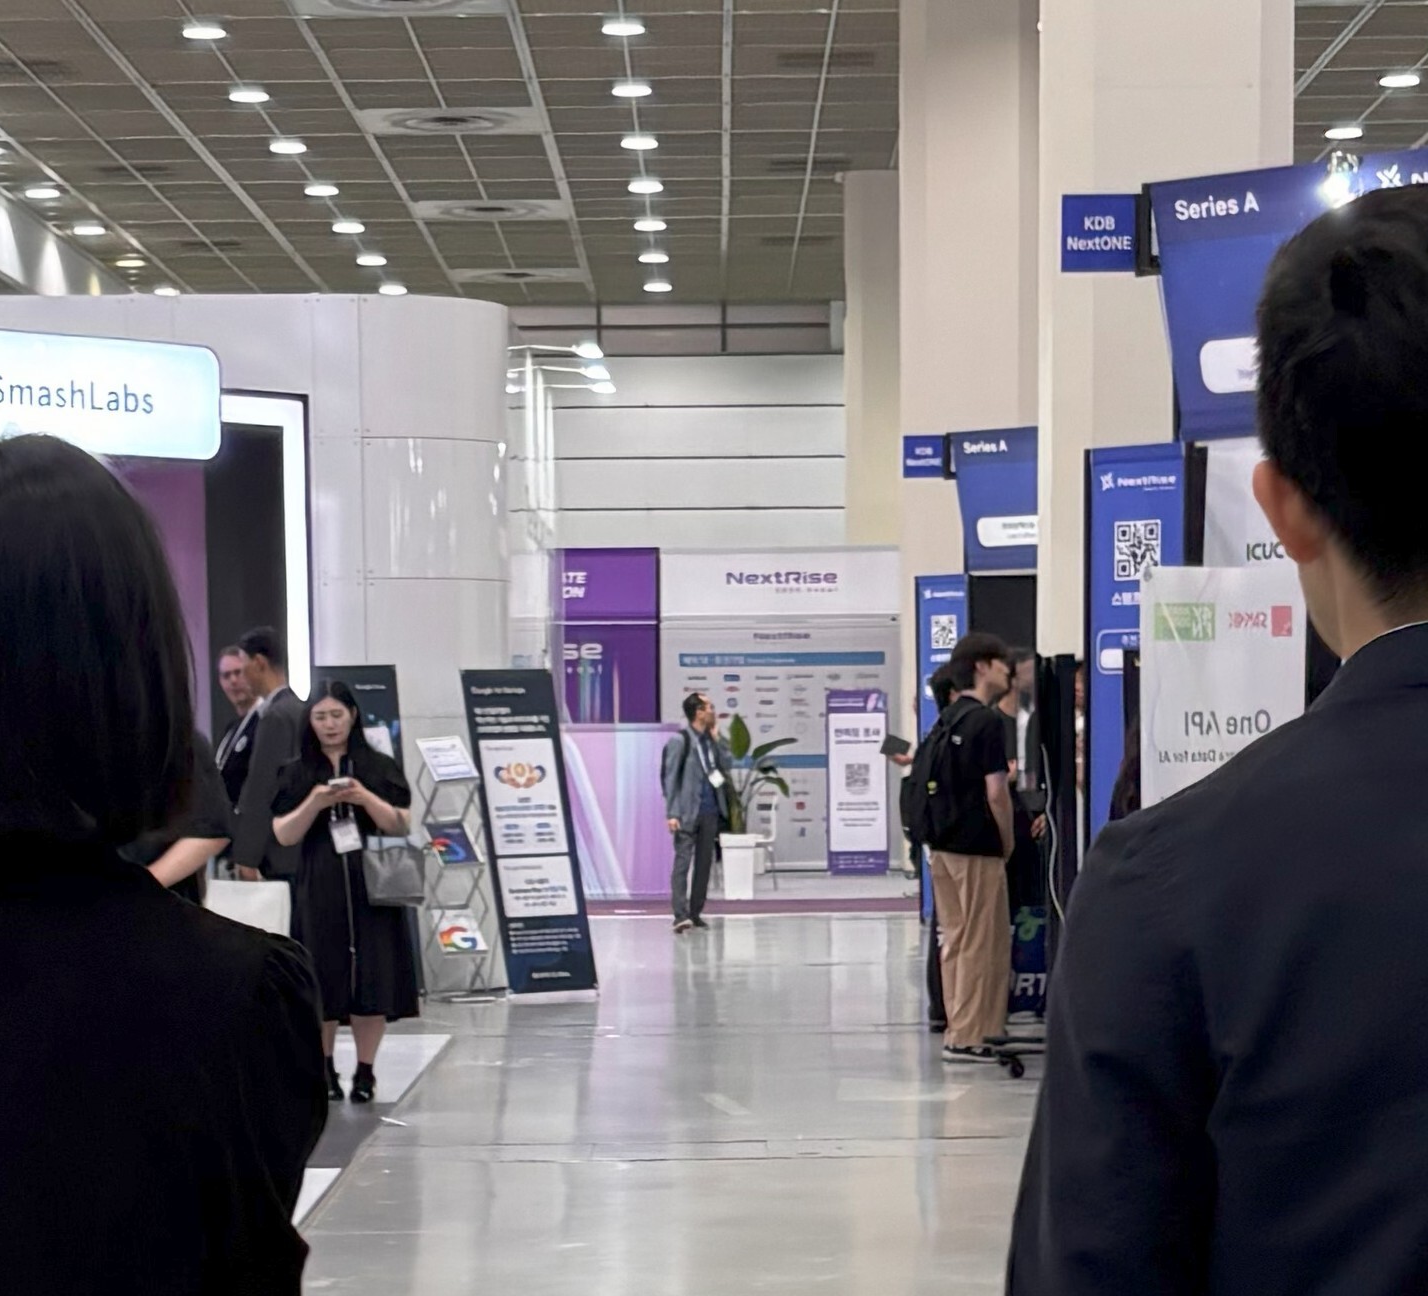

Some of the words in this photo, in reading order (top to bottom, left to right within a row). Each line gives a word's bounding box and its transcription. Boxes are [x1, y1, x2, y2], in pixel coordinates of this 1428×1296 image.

[1174, 194, 1240, 221] Series
[1243, 191, 1260, 213] A
[1084, 215, 1115, 231] KDB
[1066, 235, 1133, 251] NextONE
[962, 440, 995, 455] Series
[999, 439, 1008, 452] A
[725, 571, 838, 585] NextRise
